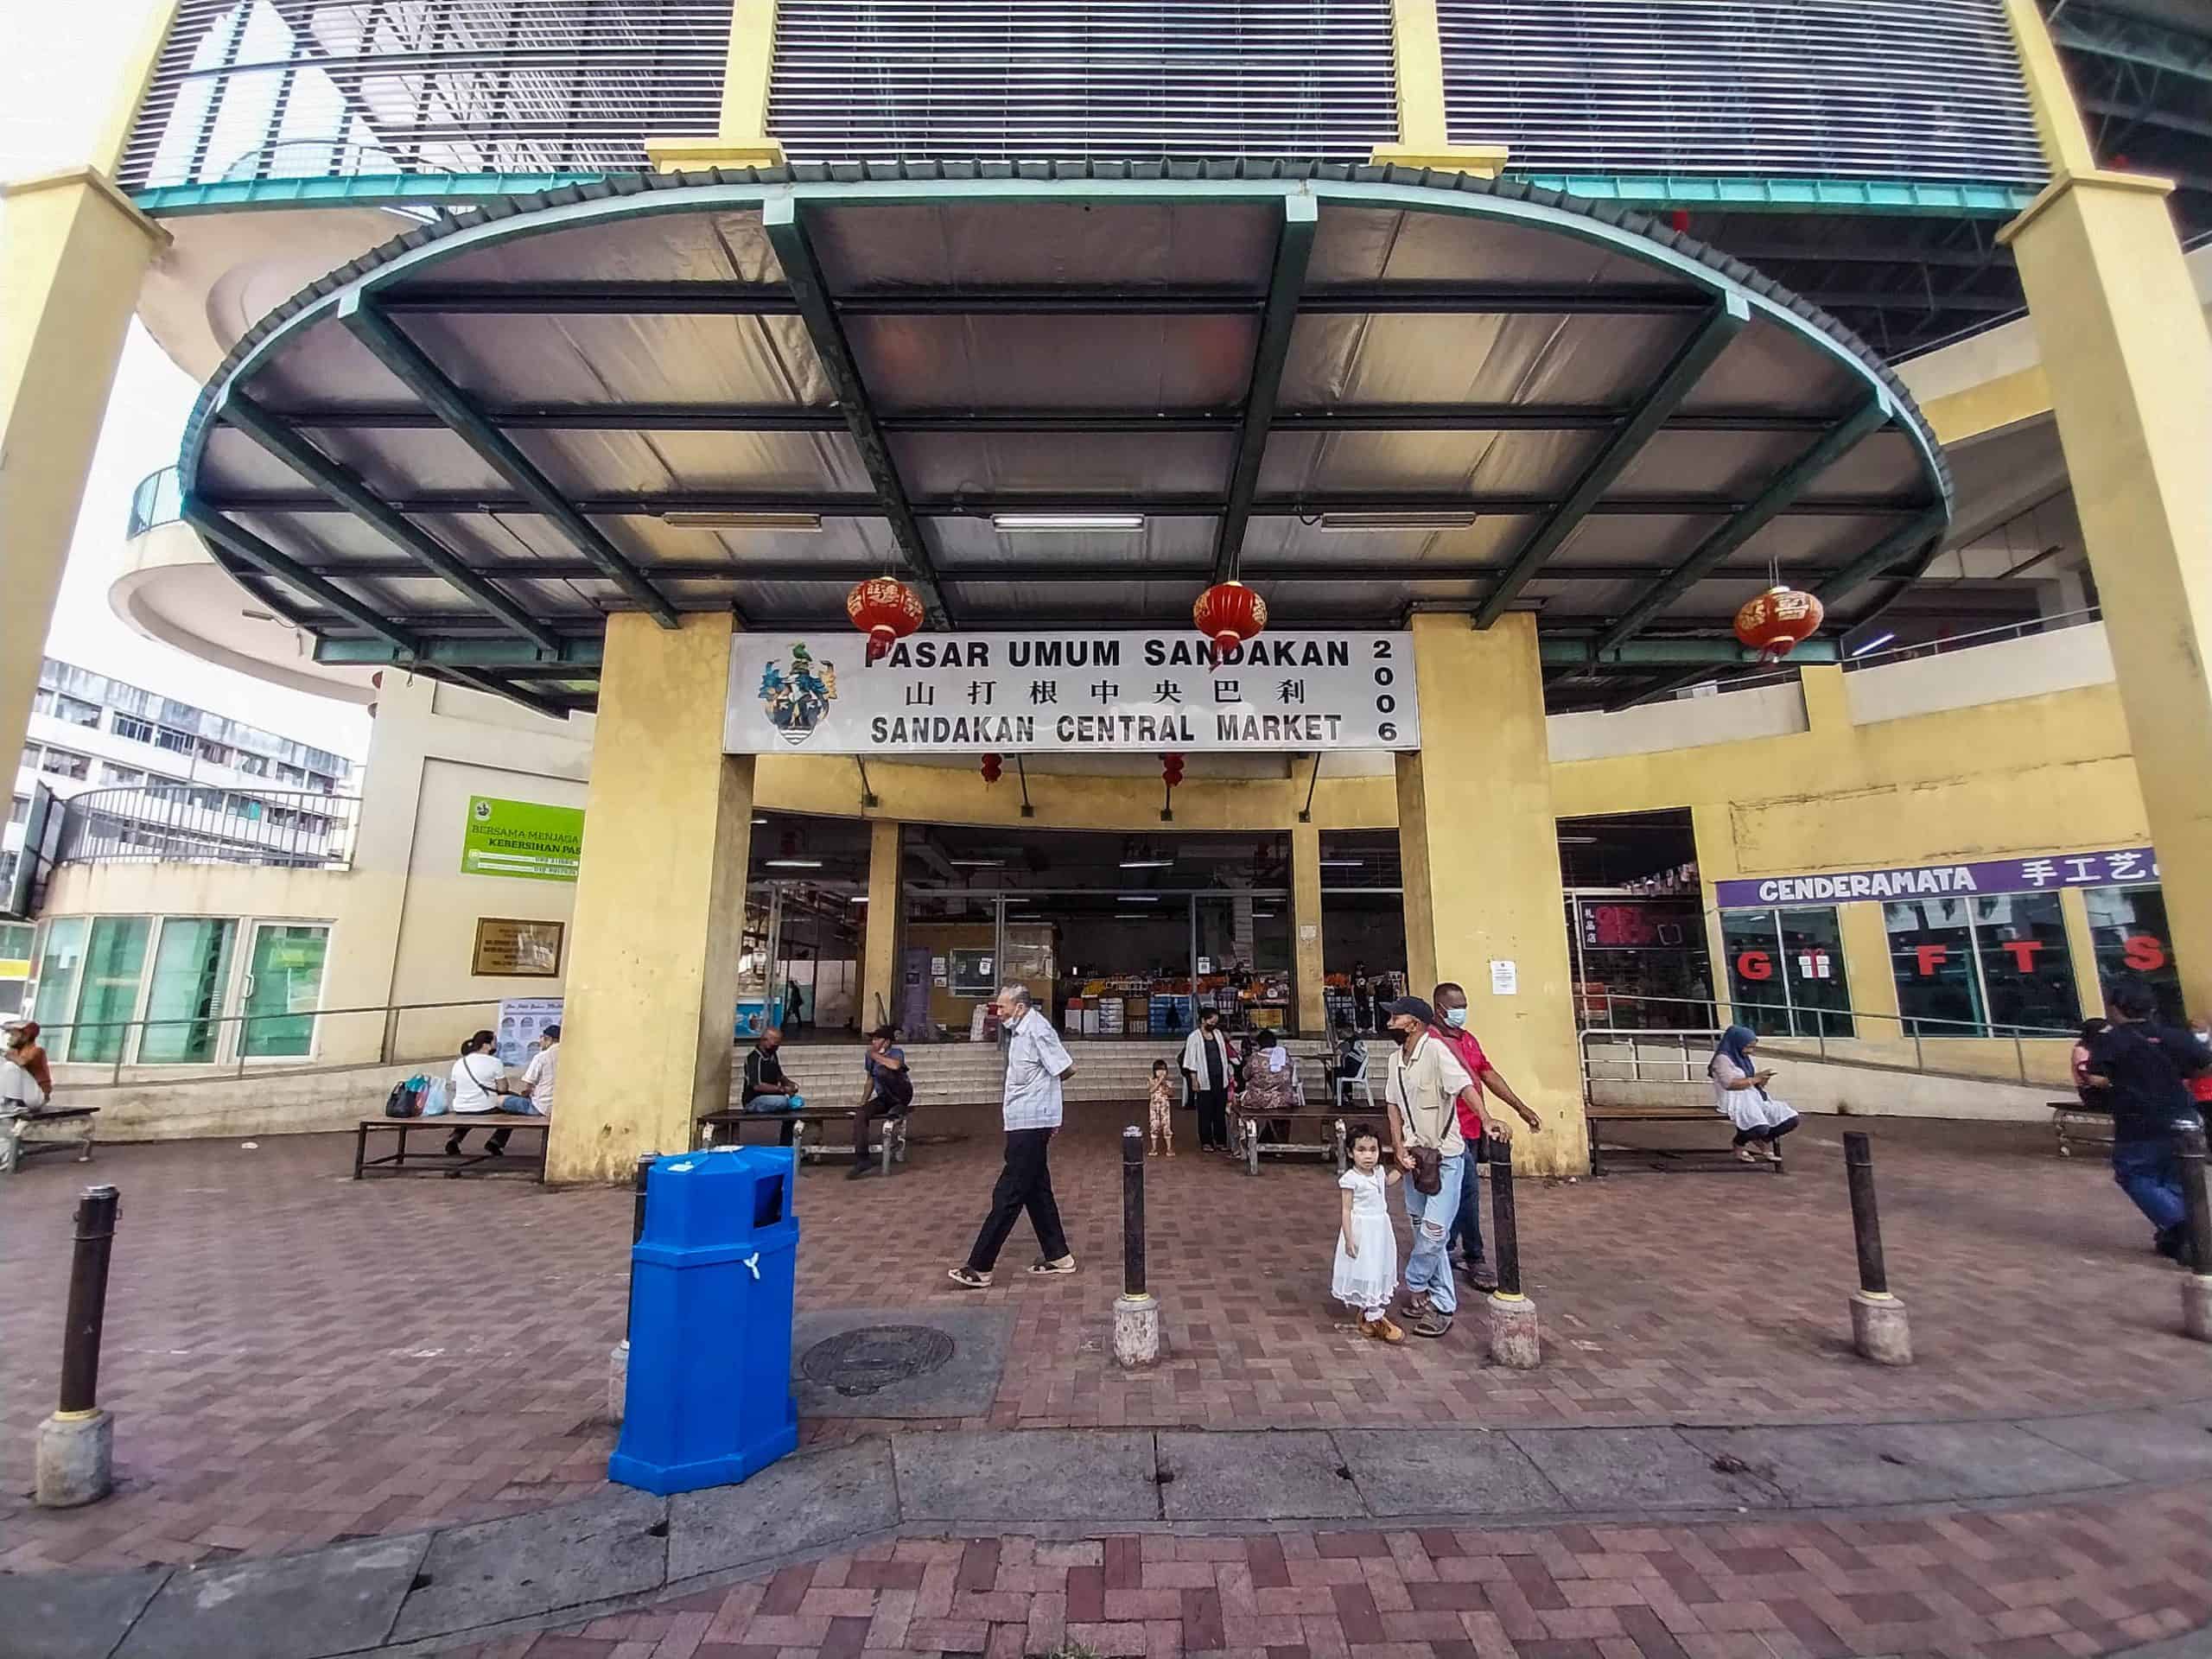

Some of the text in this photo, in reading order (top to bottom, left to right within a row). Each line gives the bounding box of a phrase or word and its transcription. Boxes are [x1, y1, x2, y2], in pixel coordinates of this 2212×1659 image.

[1008, 640, 1120, 667] UMUM
[1144, 639, 1349, 666] SANDAKAN
[1372, 639, 1398, 741] 2006
[870, 714, 1342, 743] SANDAKAN CENTRAL MARKET
[472, 824, 578, 844] BERSAMA MENJAGA
[488, 837, 560, 854] KEBERSIHAN
[1758, 867, 1978, 901] CENDERAMATA
[2021, 852, 2160, 887] 手工艺
